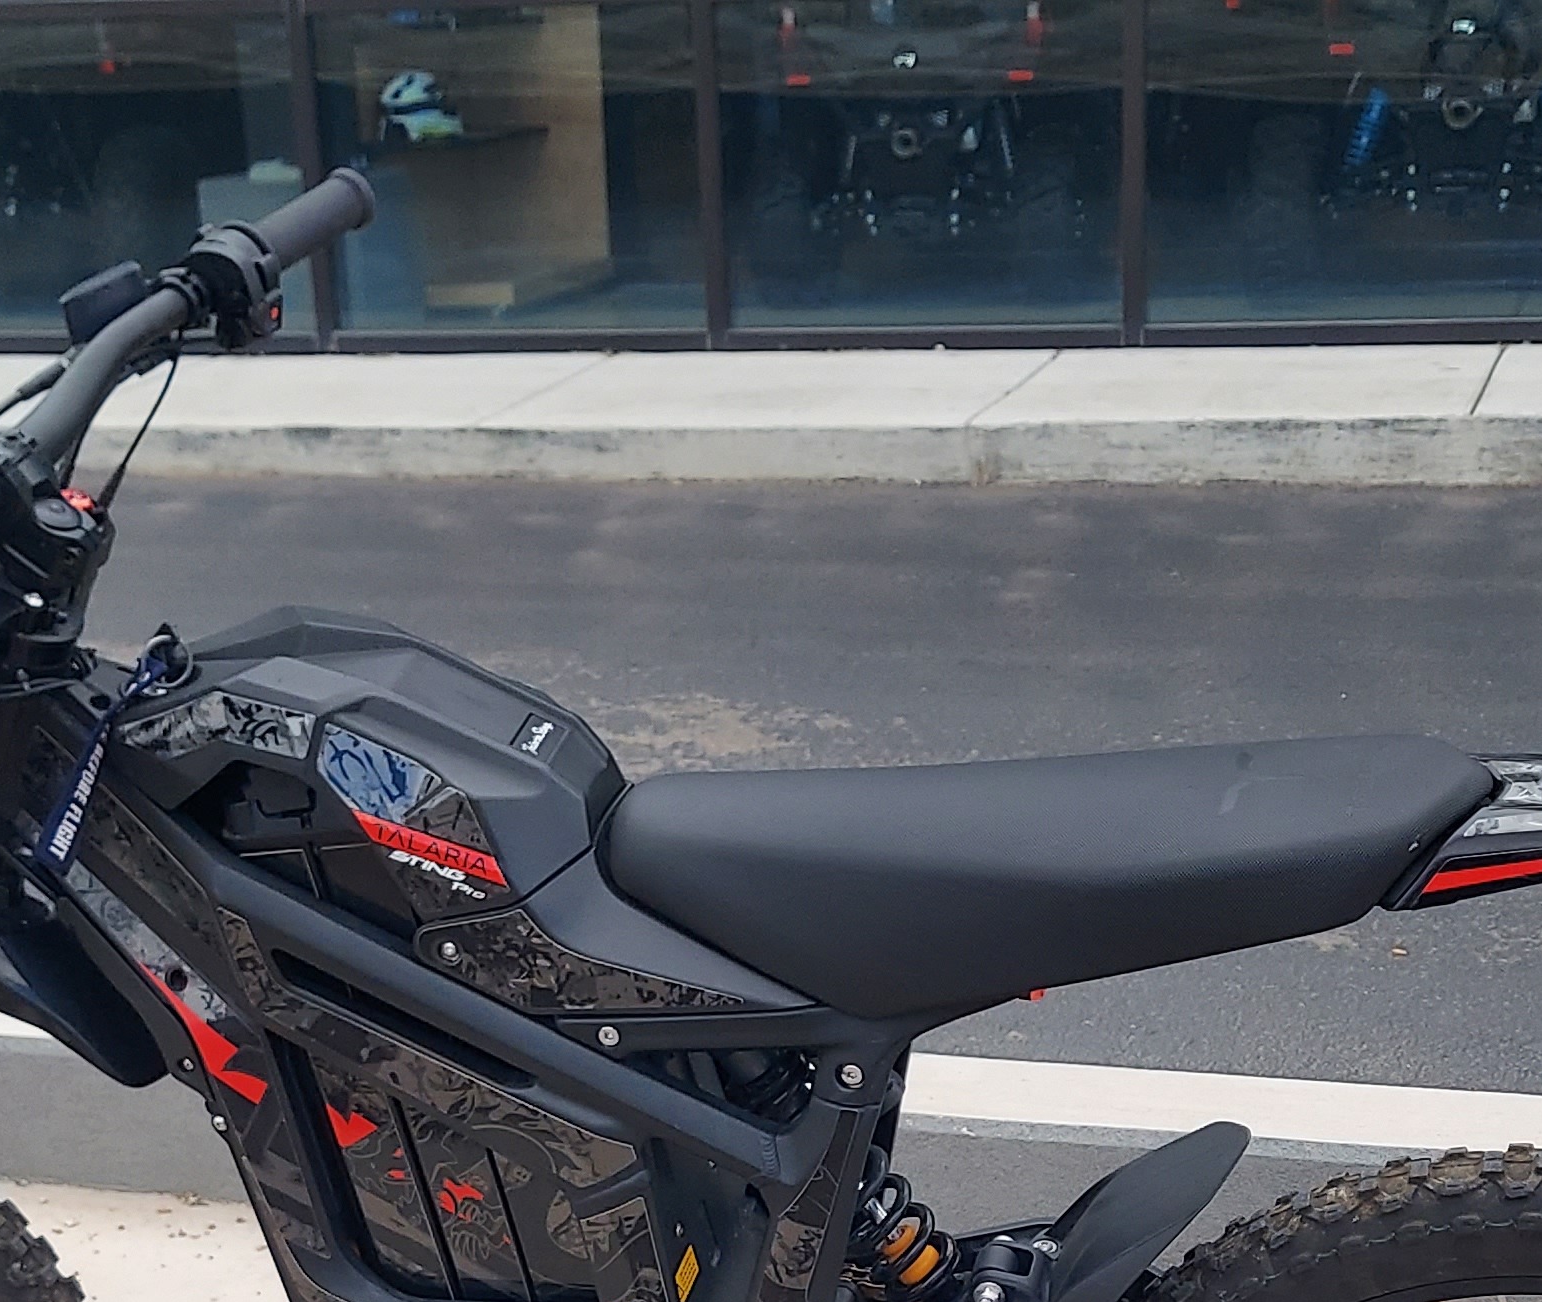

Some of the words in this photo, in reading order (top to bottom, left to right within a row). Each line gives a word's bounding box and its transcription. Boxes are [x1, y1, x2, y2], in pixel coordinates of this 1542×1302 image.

[48, 803, 84, 861] FLIGHT
[374, 823, 488, 875] TALARIA
[388, 850, 466, 882] STING
